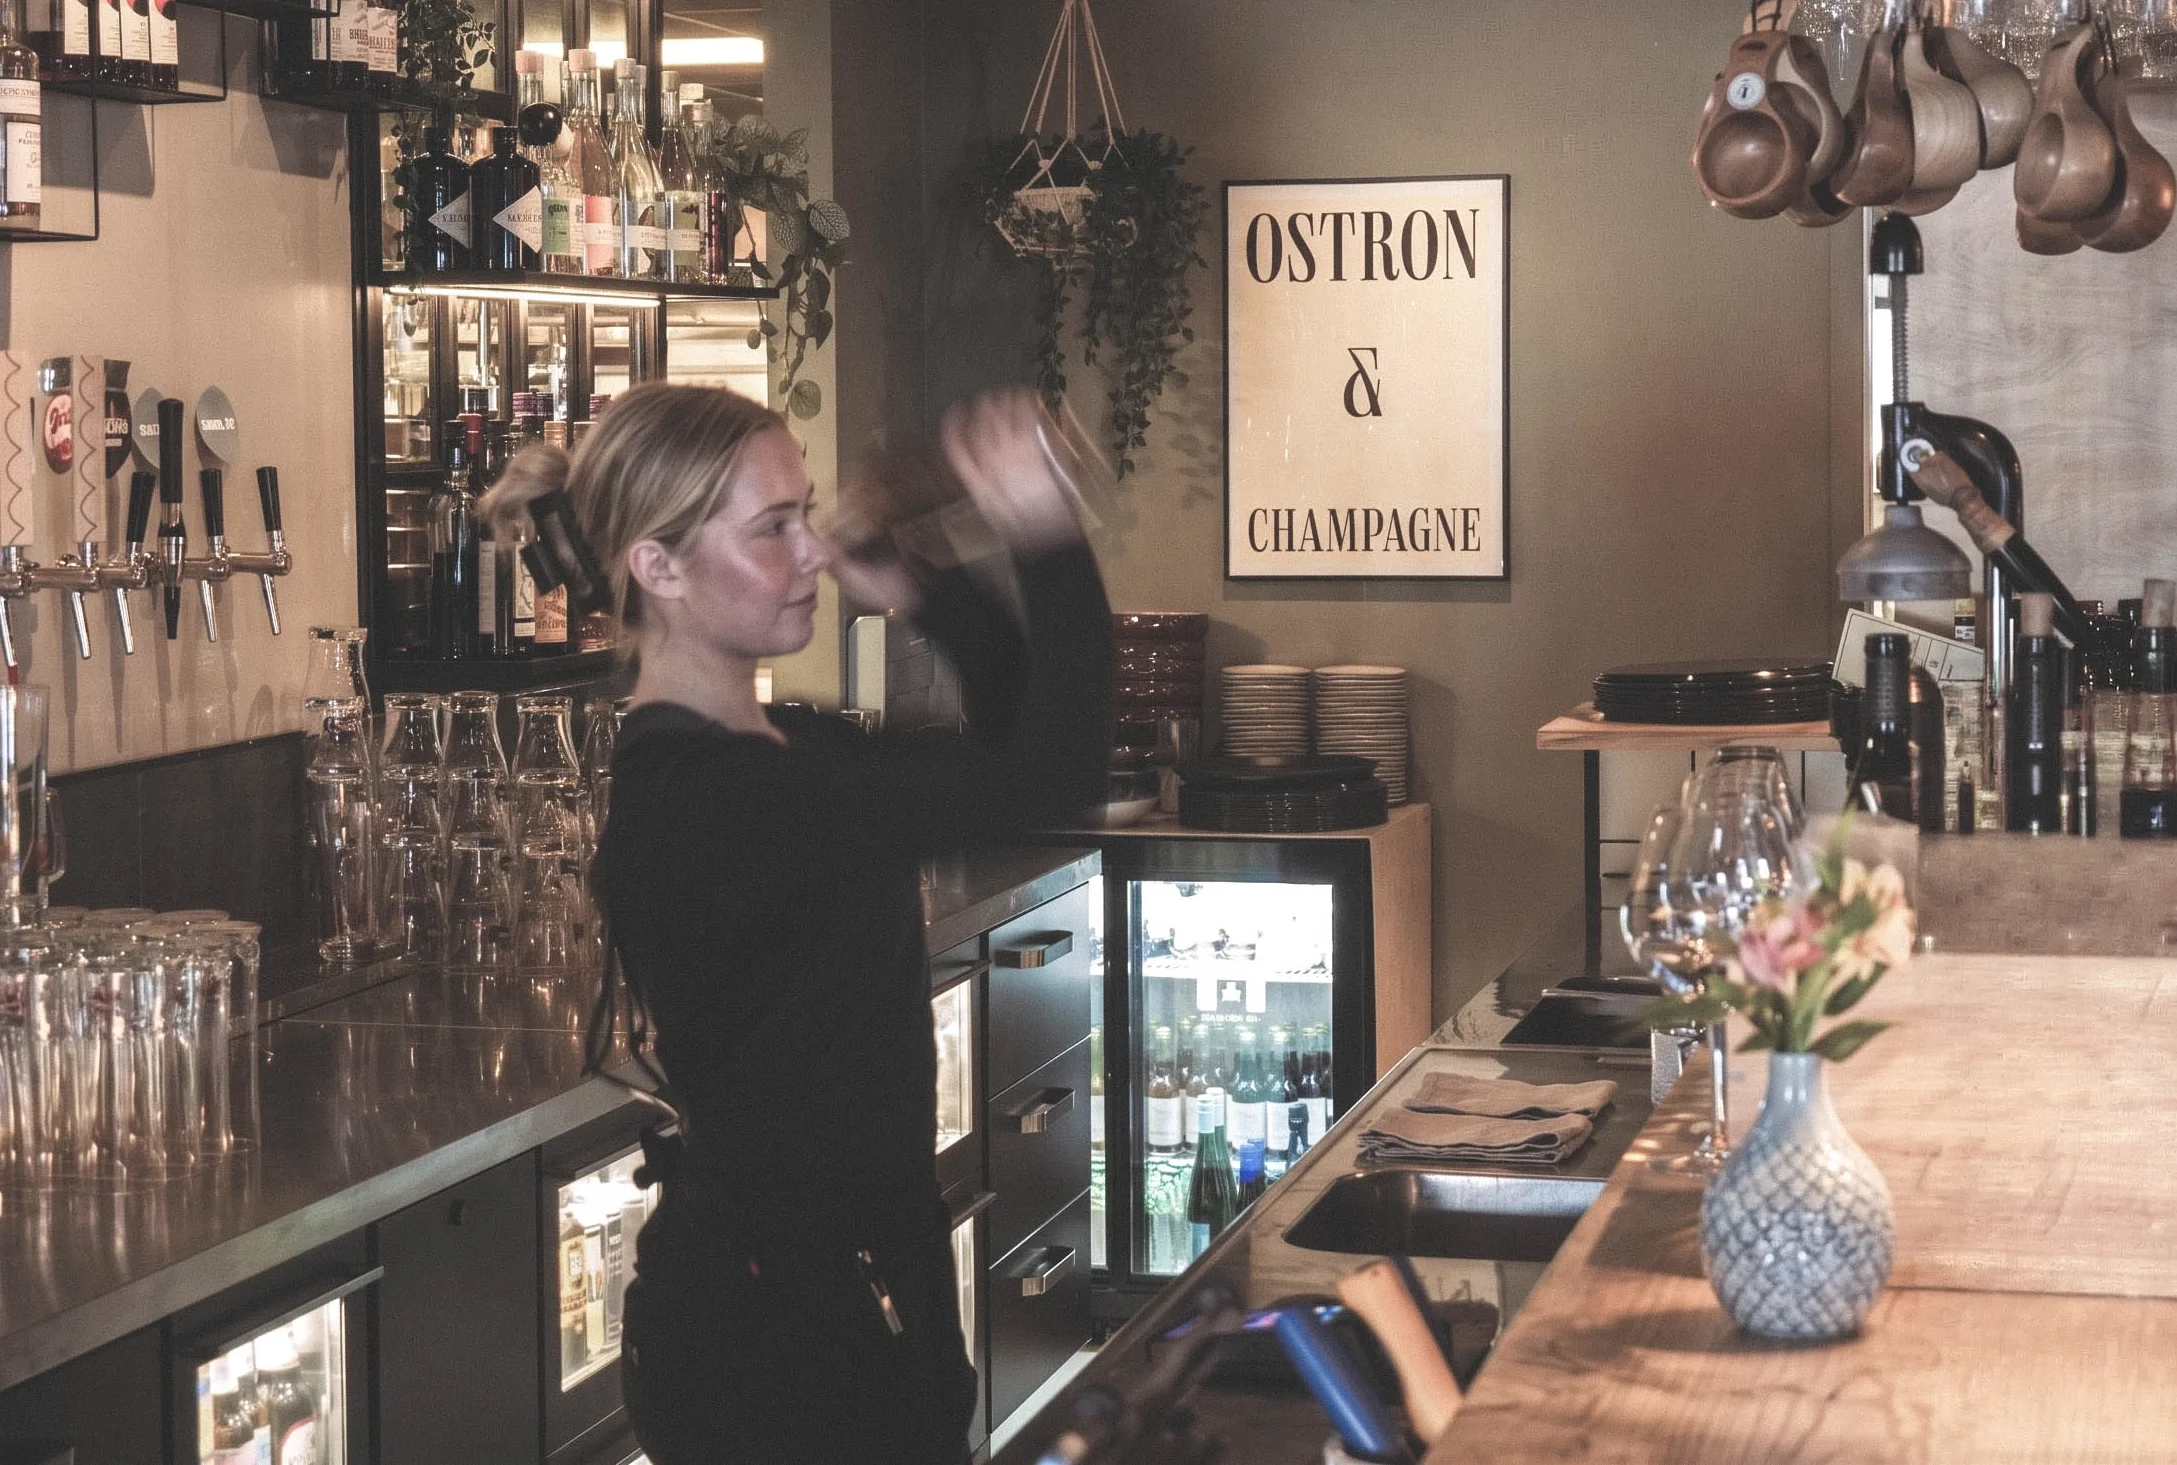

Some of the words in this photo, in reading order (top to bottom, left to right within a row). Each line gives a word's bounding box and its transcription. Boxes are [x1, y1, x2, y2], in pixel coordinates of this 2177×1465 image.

[1246, 209, 1480, 283] OSTRON
[1343, 347, 1382, 418] &
[1248, 507, 1481, 553] CHAMPAGNE
